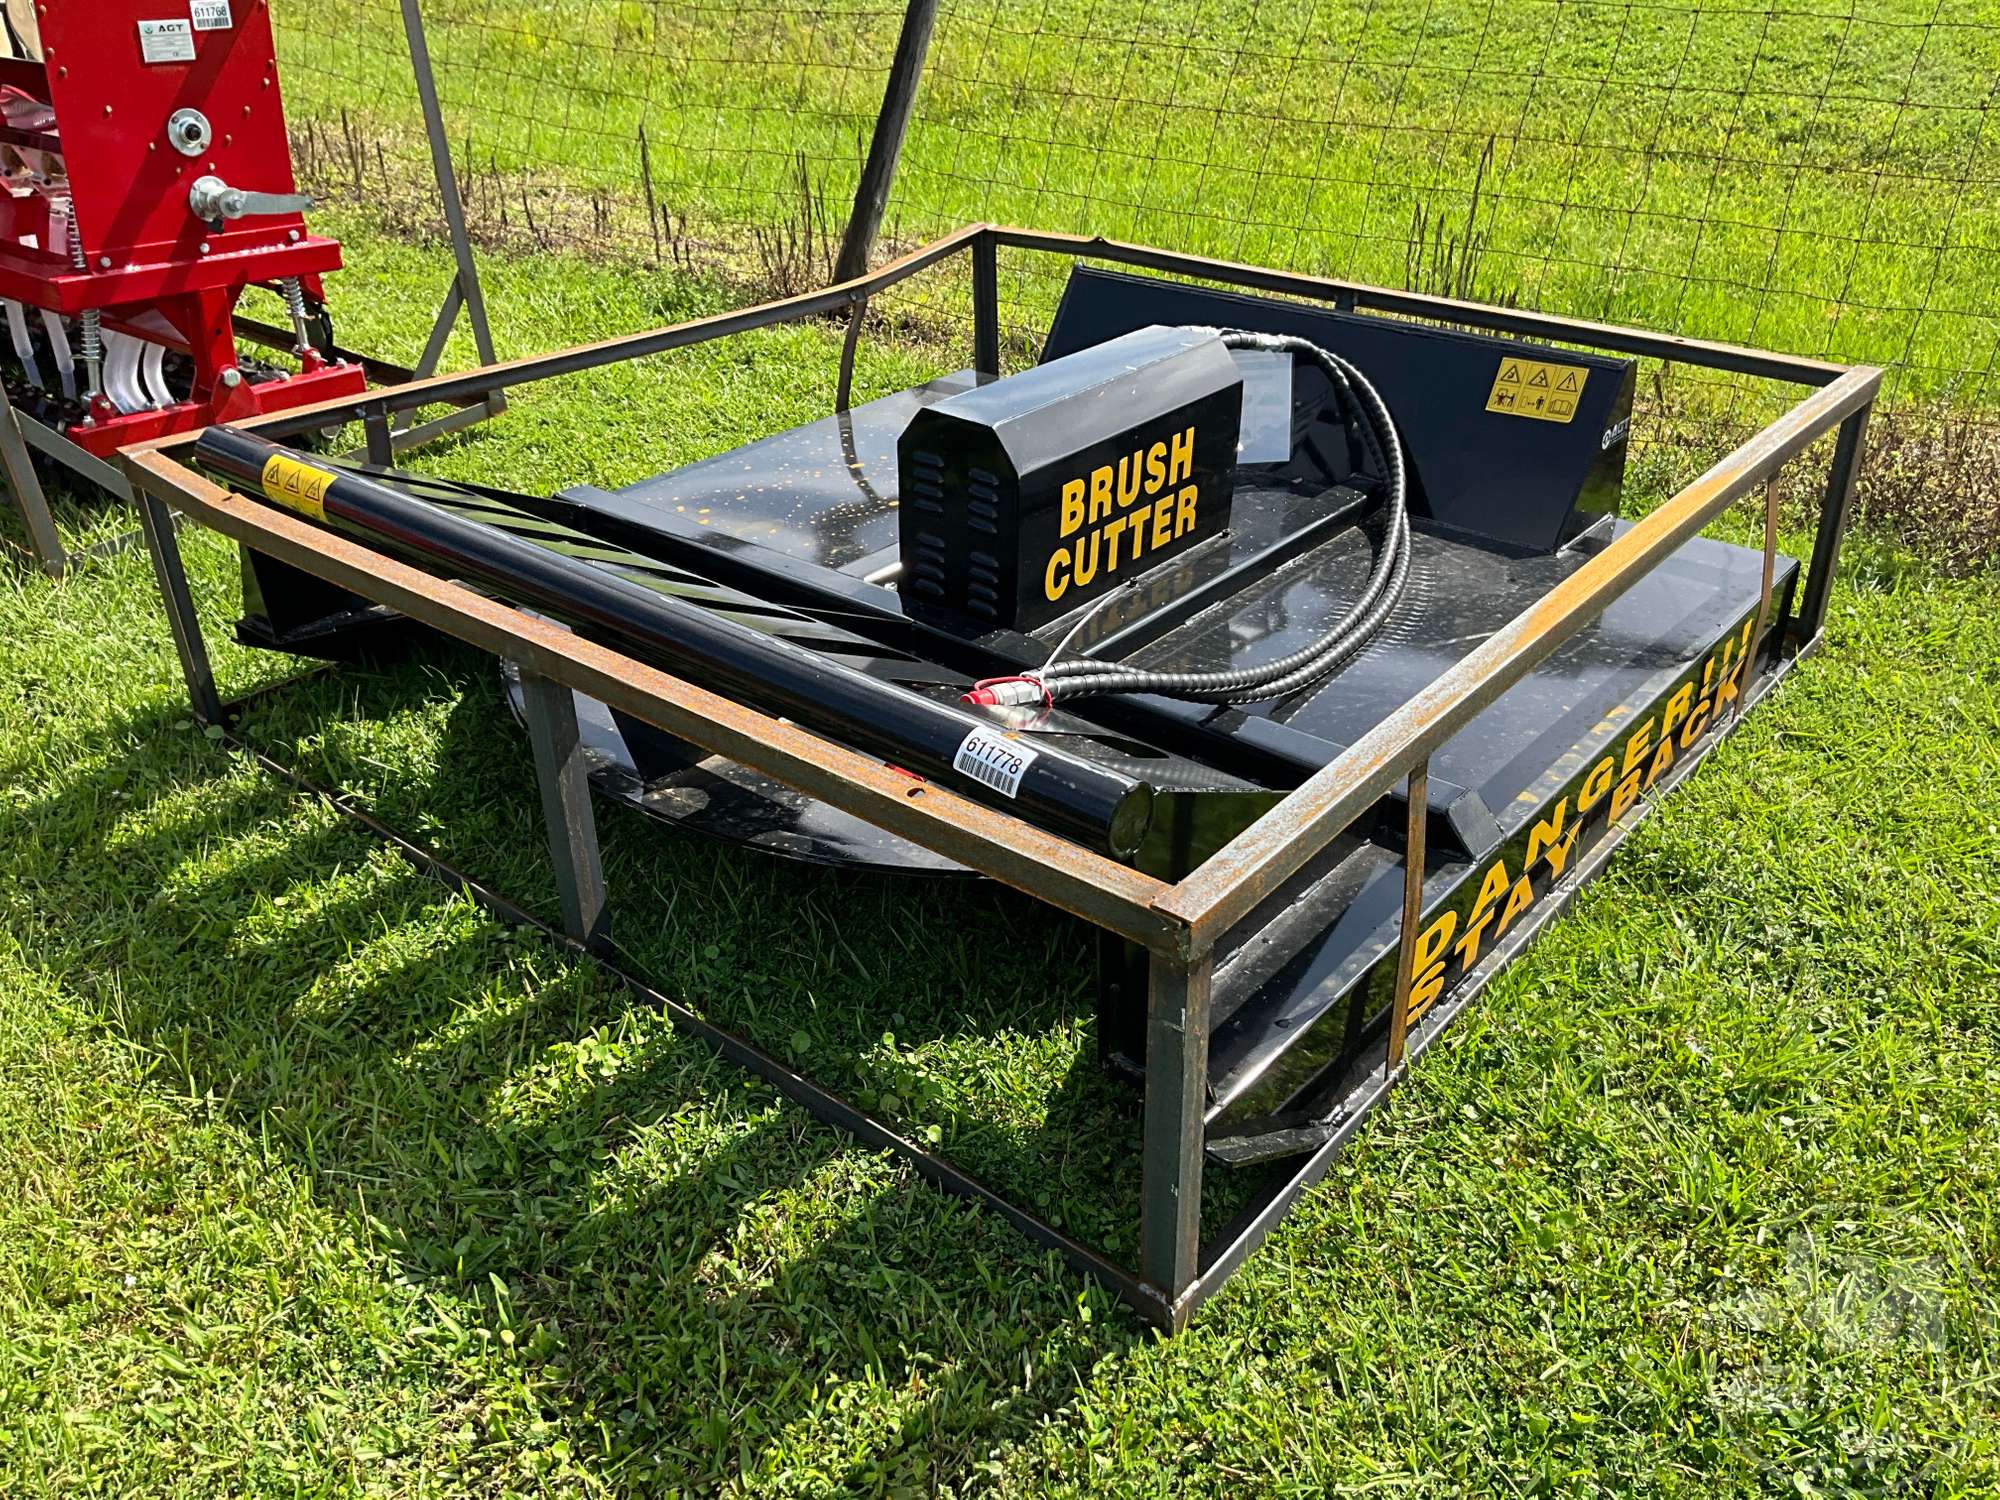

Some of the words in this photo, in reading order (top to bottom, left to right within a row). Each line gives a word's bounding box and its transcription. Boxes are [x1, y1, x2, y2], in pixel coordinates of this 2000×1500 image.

[159, 24, 183, 32] AGT
[194, 6, 227, 17] 611768
[1060, 426, 1195, 539] BRUSH
[1045, 484, 1198, 601] CUTTER
[966, 737, 1023, 775] 611778
[1406, 819, 1582, 1026] STAY
[1608, 659, 1744, 828] BACK
